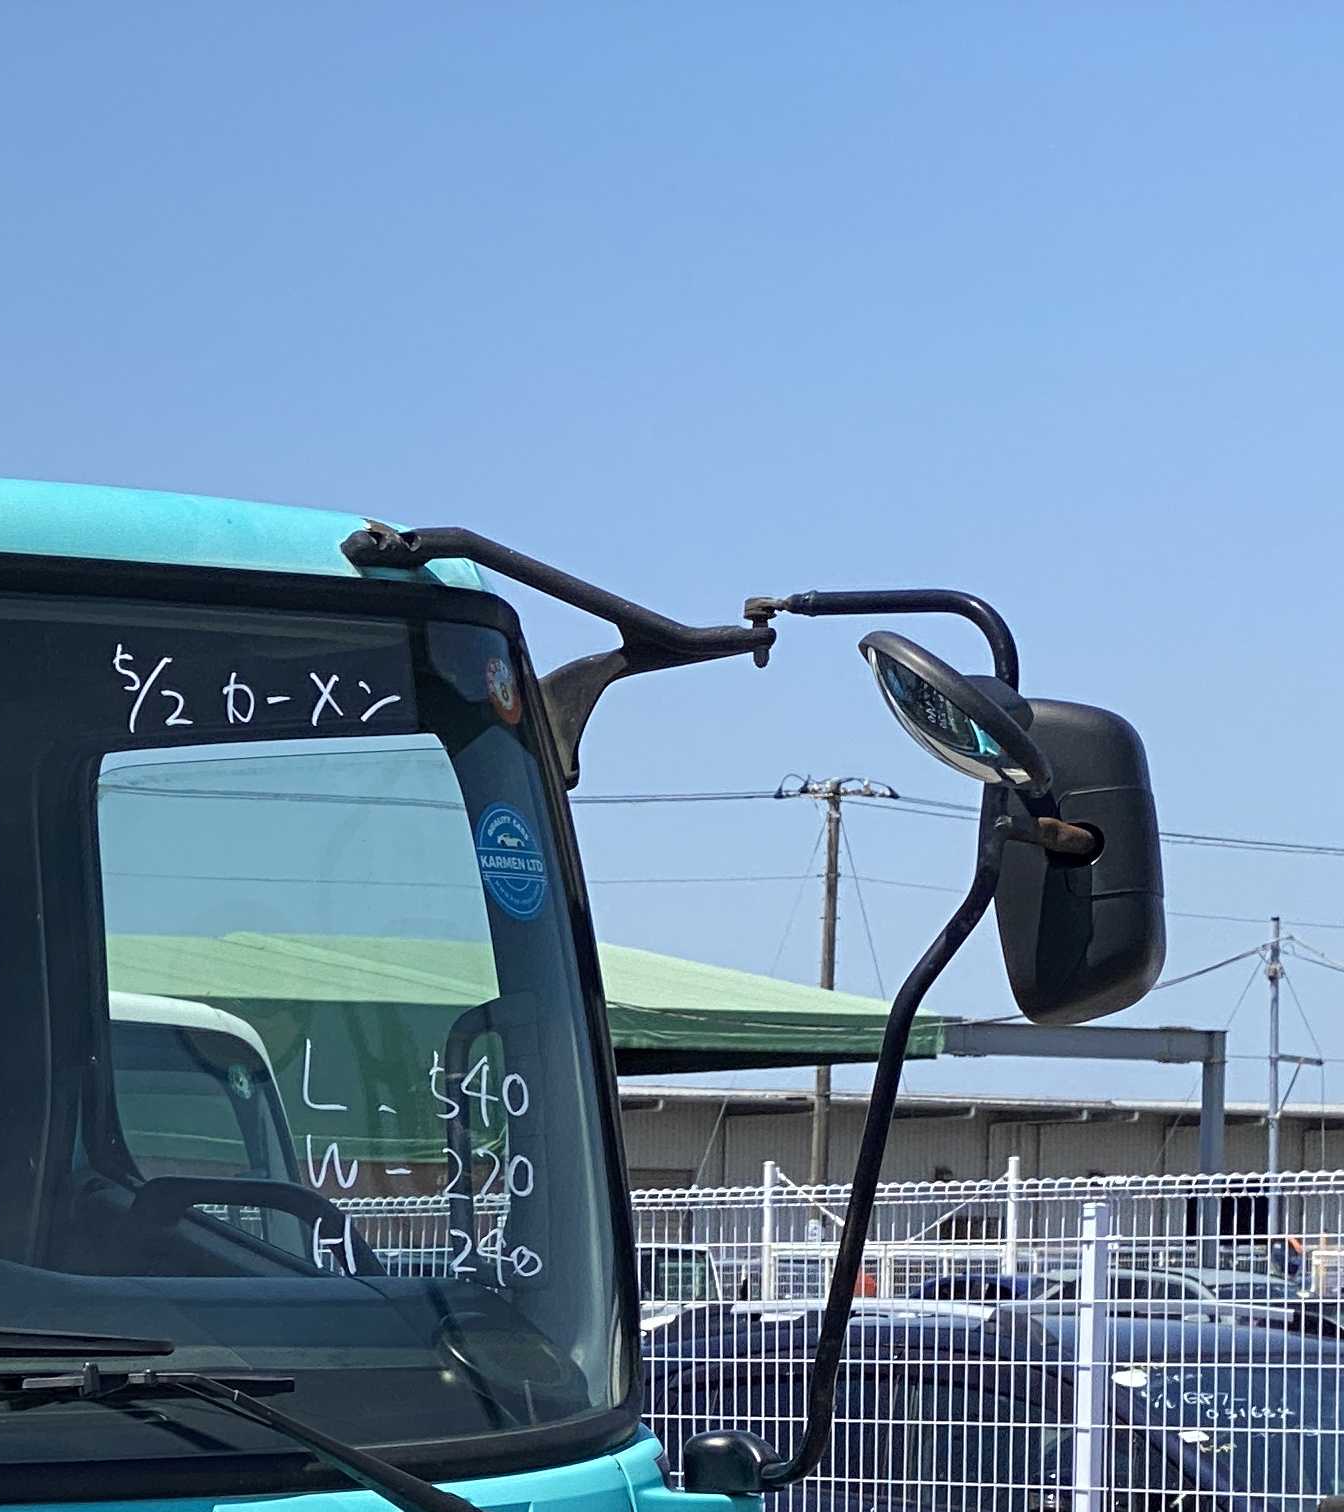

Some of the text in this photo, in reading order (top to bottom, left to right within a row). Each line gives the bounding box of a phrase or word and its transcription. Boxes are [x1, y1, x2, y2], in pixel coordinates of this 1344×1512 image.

[113, 643, 193, 734] 5/2
[480, 855, 544, 873] KARMEN LTD
[302, 1038, 348, 1111] L
[429, 1050, 529, 1128] 540
[306, 1133, 359, 1189] W
[442, 1147, 534, 1198] 220
[313, 1216, 357, 1276] H
